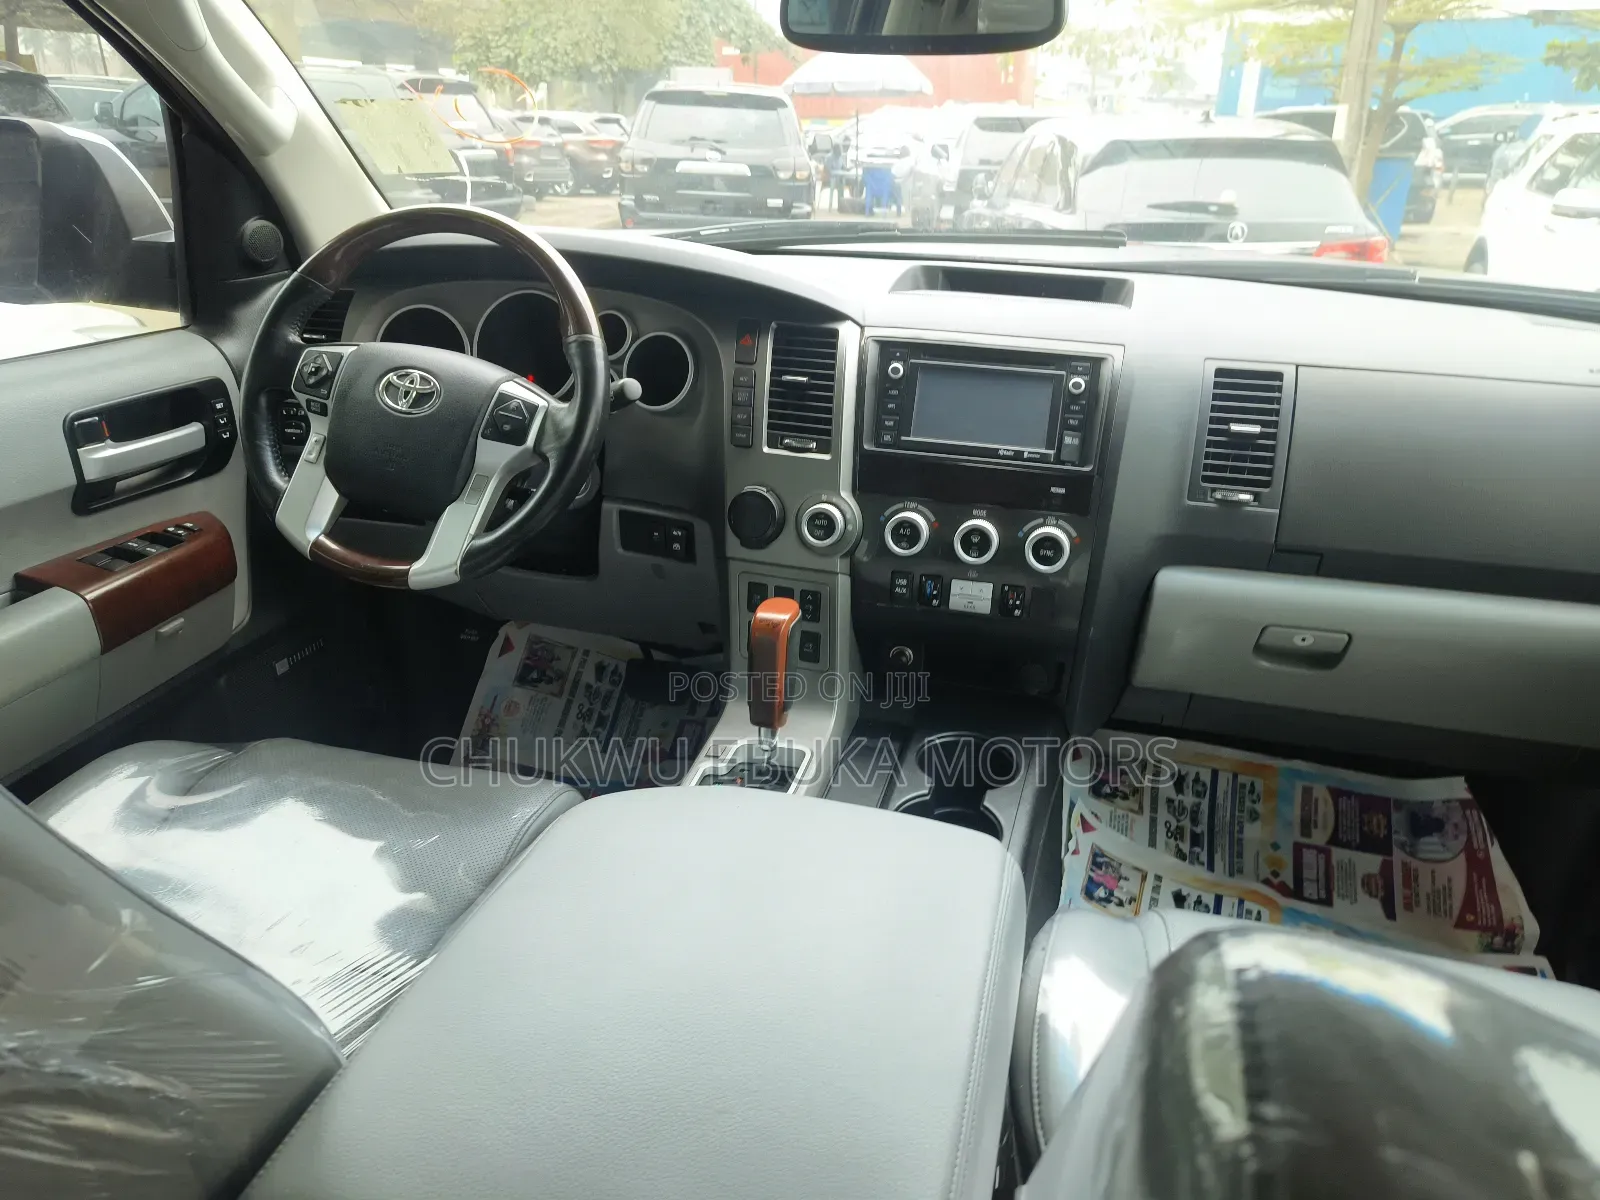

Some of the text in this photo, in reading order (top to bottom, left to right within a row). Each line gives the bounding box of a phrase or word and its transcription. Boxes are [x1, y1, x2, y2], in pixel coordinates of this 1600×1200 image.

[904, 501, 918, 509] TEMP
[973, 509, 987, 517] MODE
[814, 518, 828, 526] AUTO
[899, 527, 911, 536] A/C
[895, 578, 908, 586] USB
[895, 586, 907, 594] AUX
